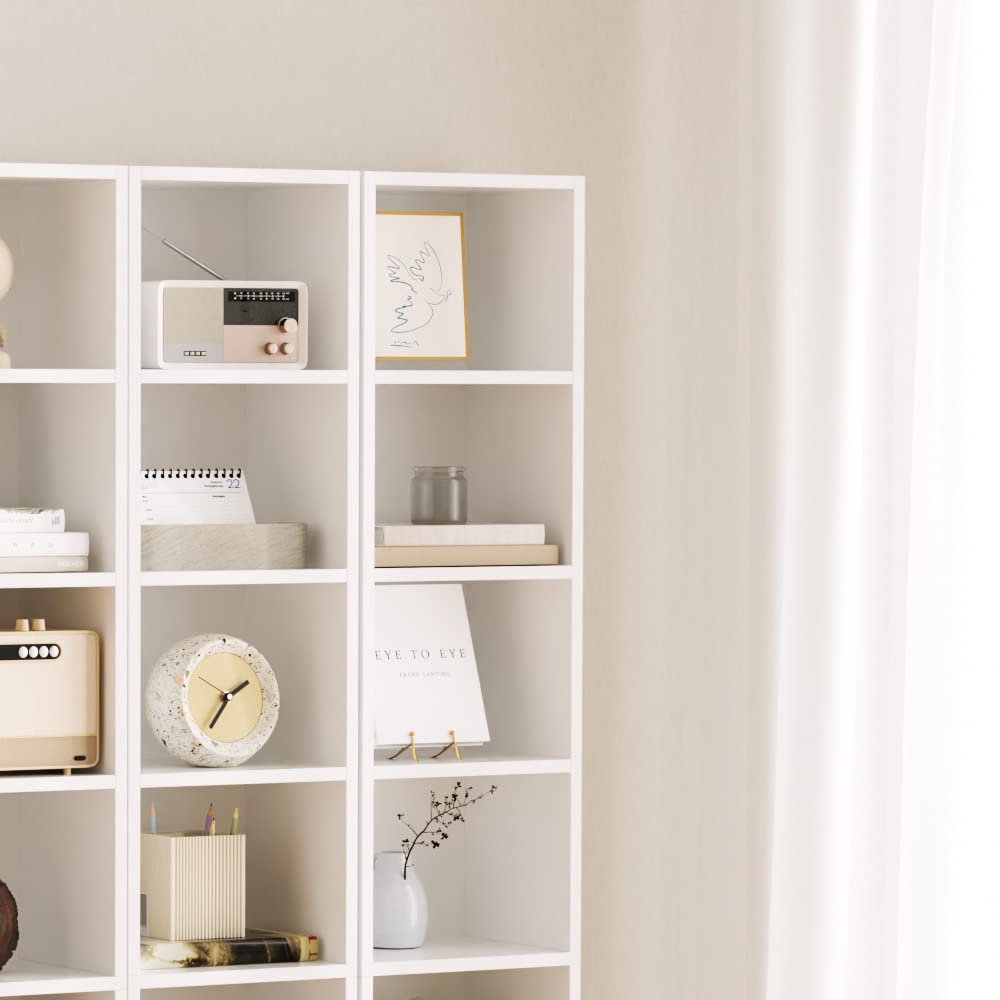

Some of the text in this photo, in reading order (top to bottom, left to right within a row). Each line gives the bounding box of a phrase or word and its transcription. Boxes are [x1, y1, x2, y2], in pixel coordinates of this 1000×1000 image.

[226, 478, 241, 489] 22
[374, 648, 467, 660] EYE TO EYE
